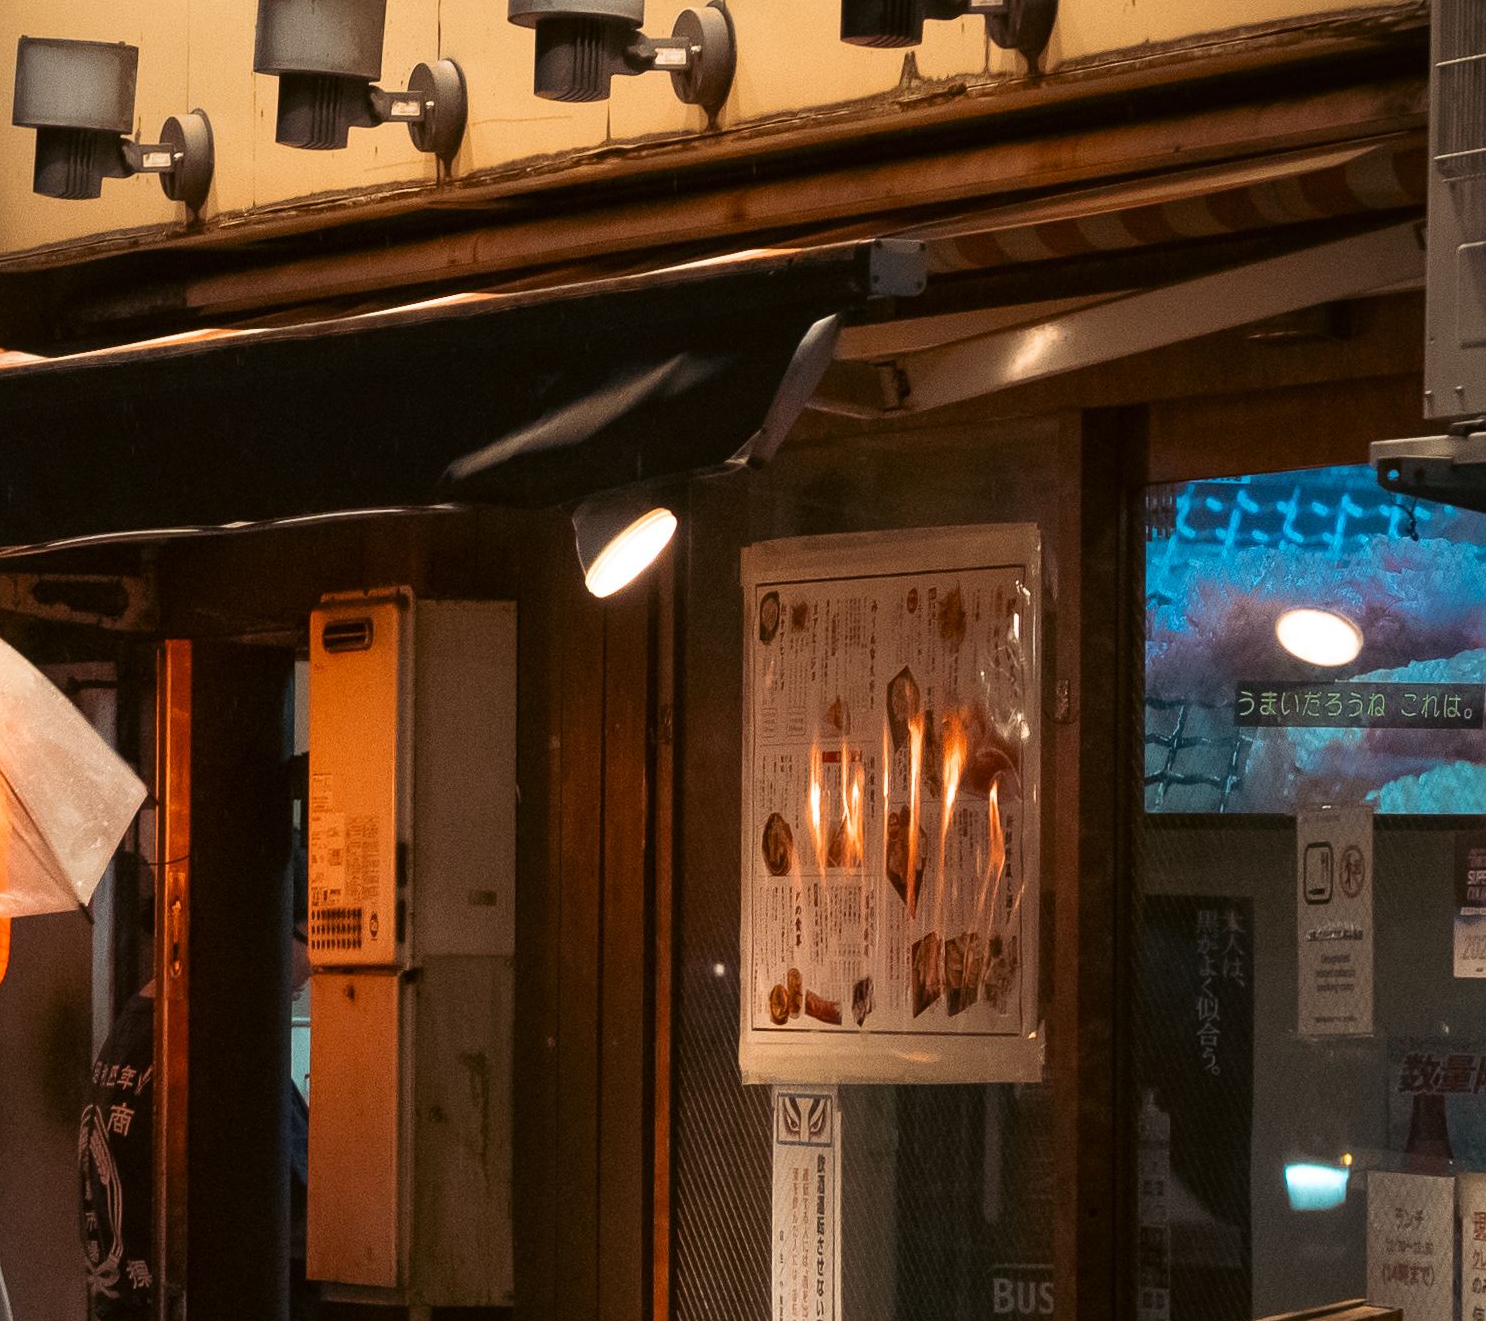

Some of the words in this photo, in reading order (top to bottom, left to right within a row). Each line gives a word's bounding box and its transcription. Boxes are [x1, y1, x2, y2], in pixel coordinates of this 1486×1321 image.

[1238, 690, 1386, 718] うまいだろうね
[1402, 691, 1474, 721] これは。
[1195, 909, 1221, 1077] 黒がよく似合う。
[108, 1103, 135, 1137] 商
